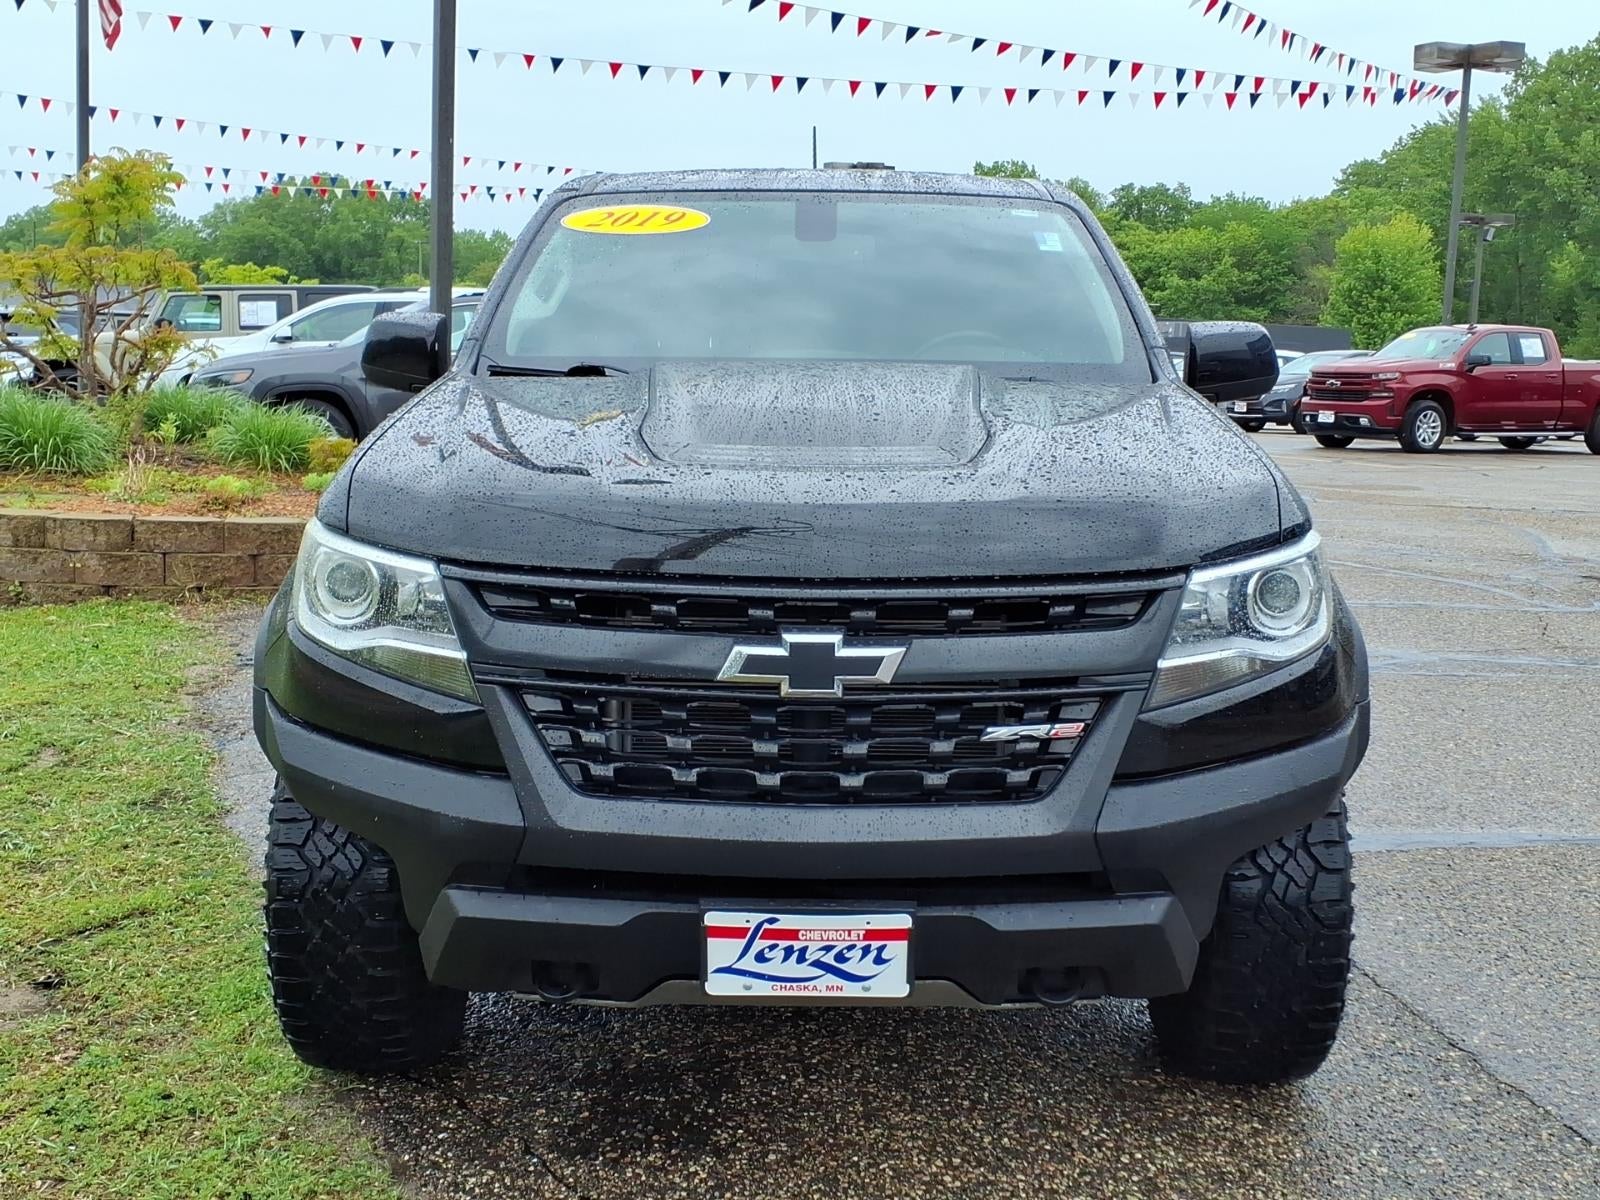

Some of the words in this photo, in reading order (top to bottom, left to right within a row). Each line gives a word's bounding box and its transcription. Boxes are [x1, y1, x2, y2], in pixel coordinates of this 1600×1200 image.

[586, 210, 687, 228] 2019
[980, 722, 1085, 742] ZR2
[798, 929, 866, 941] CHEVROLET
[710, 916, 897, 983] Lenzen
[771, 983, 822, 993] CHASKA,
[825, 984, 844, 993] MN
